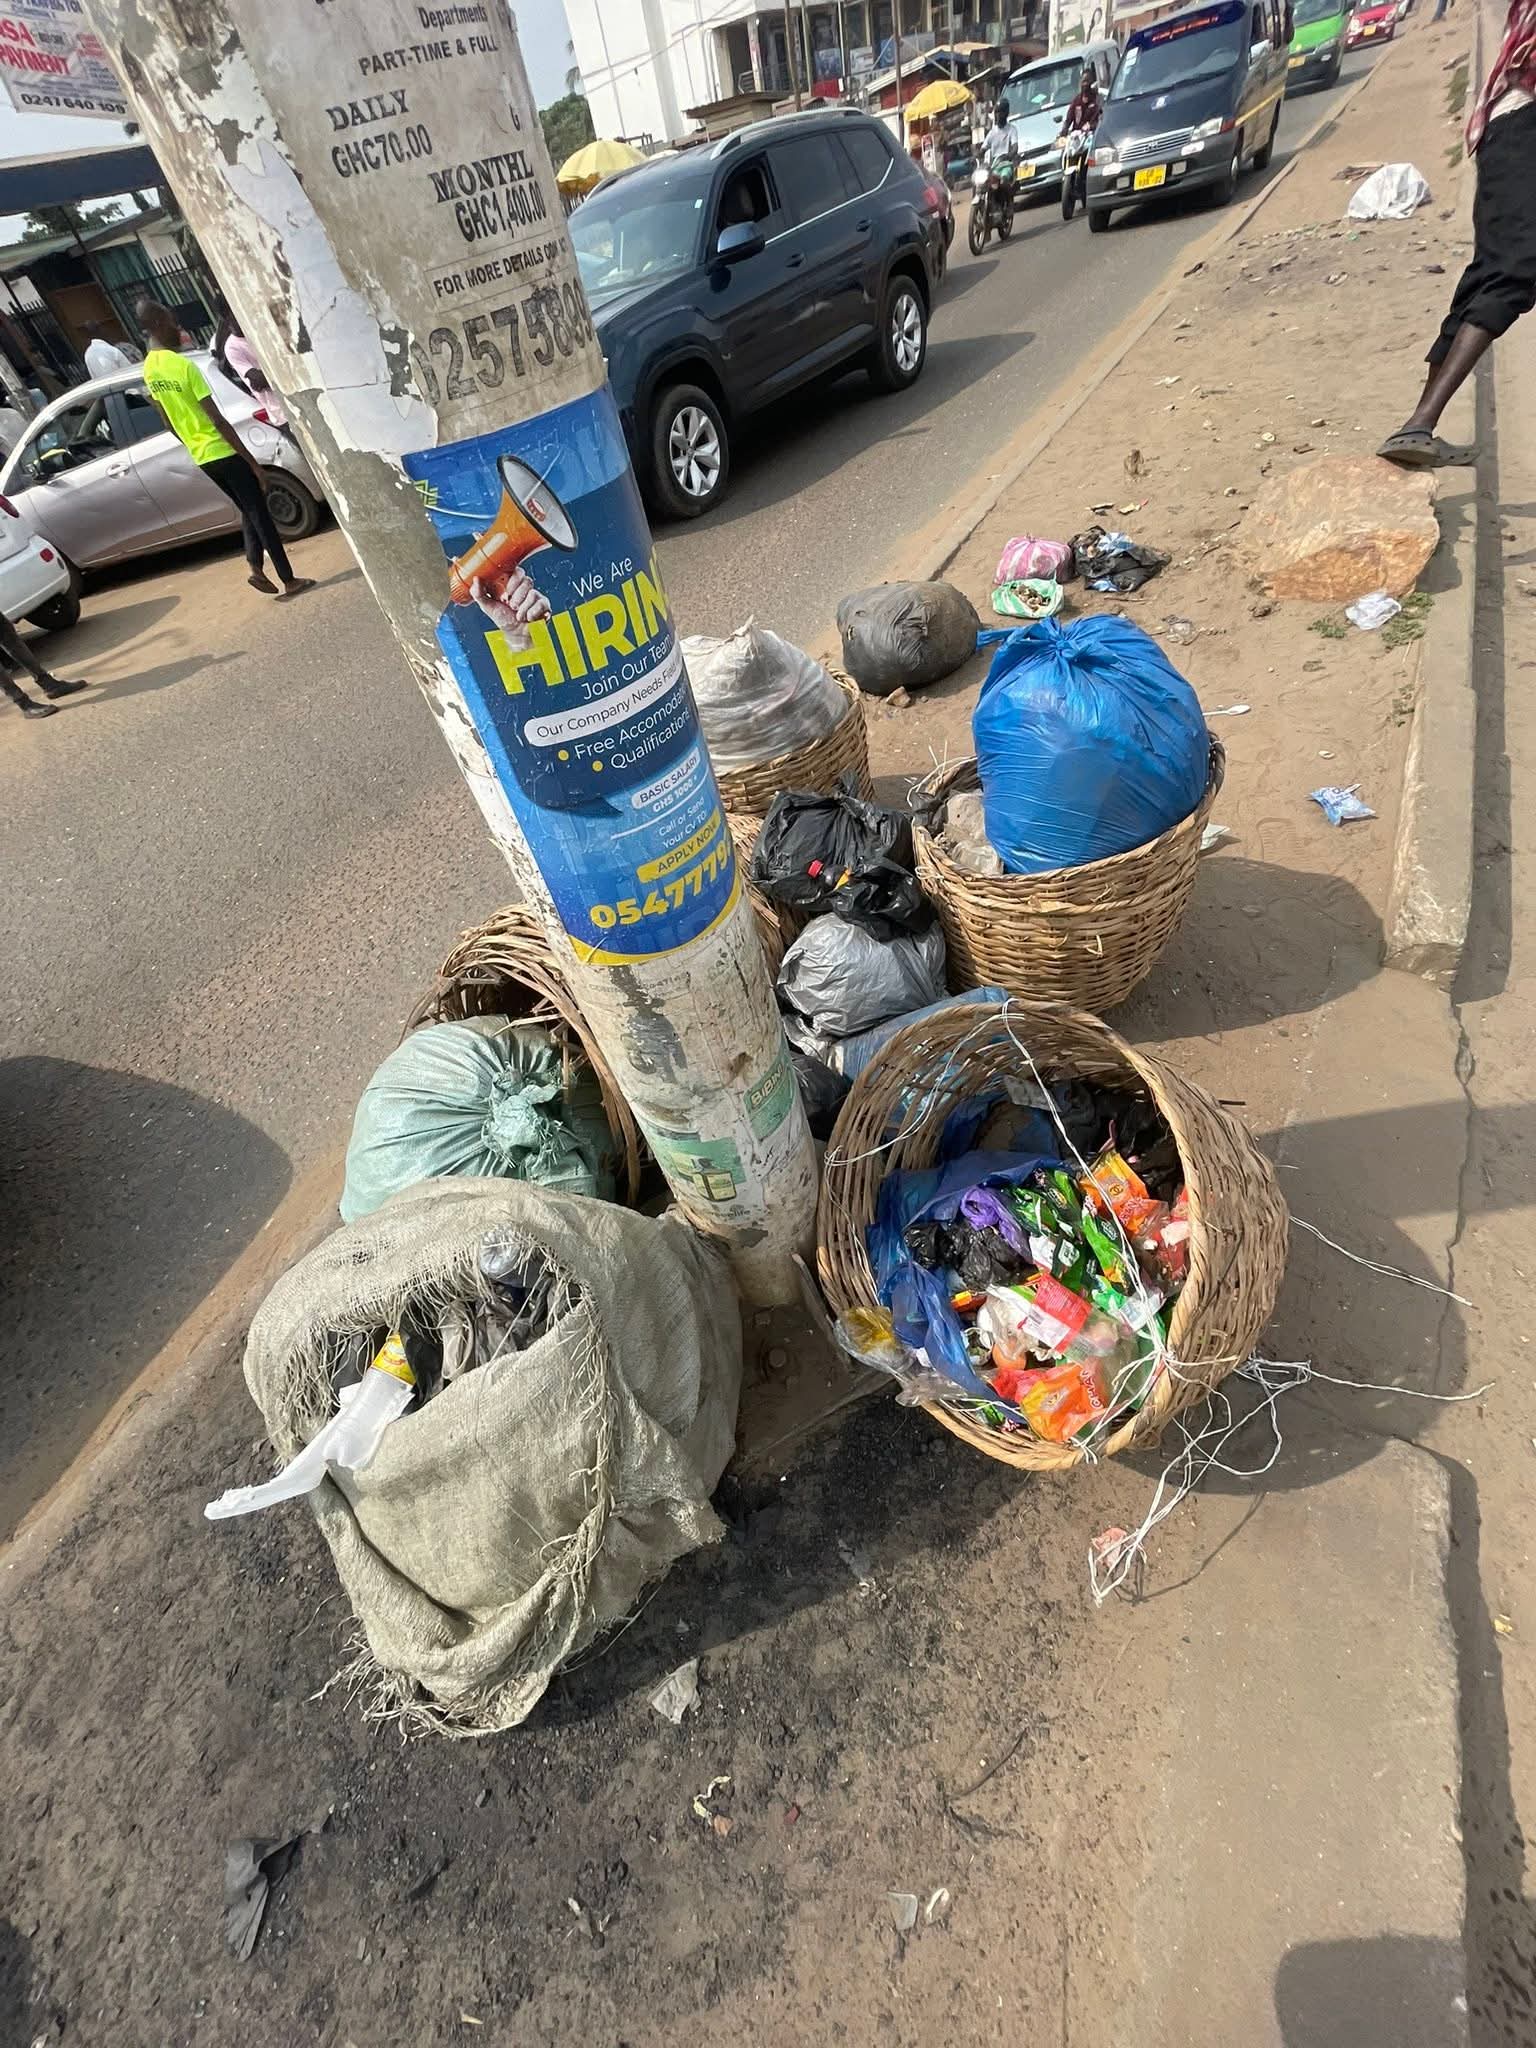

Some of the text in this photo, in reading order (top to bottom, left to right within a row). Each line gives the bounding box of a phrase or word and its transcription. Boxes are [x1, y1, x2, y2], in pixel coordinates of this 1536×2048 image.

[0, 18, 35, 47] SA
[417, 4, 488, 32] Departments
[358, 35, 498, 76] PART-TIME & FULL
[325, 88, 410, 132] DAILY
[331, 123, 433, 178] GHC70.00
[454, 180, 547, 242] GHC1,400.00
[433, 277, 466, 298] FOR
[465, 261, 503, 288] MORE
[502, 246, 544, 275] DETAILS
[572, 557, 633, 597] We Are
[484, 546, 667, 696] HIRIN
[581, 675, 619, 700] Join
[621, 656, 650, 681] Our
[536, 722, 564, 738] Our
[567, 698, 631, 731] Company
[632, 677, 663, 704] Needs
[574, 737, 615, 760] Free
[640, 780, 670, 803] BASIC
[659, 818, 676, 836] Call
[678, 814, 687, 825] or
[662, 831, 684, 849] Your
[657, 841, 694, 873] APPLY
[590, 834, 730, 929] 0547779
